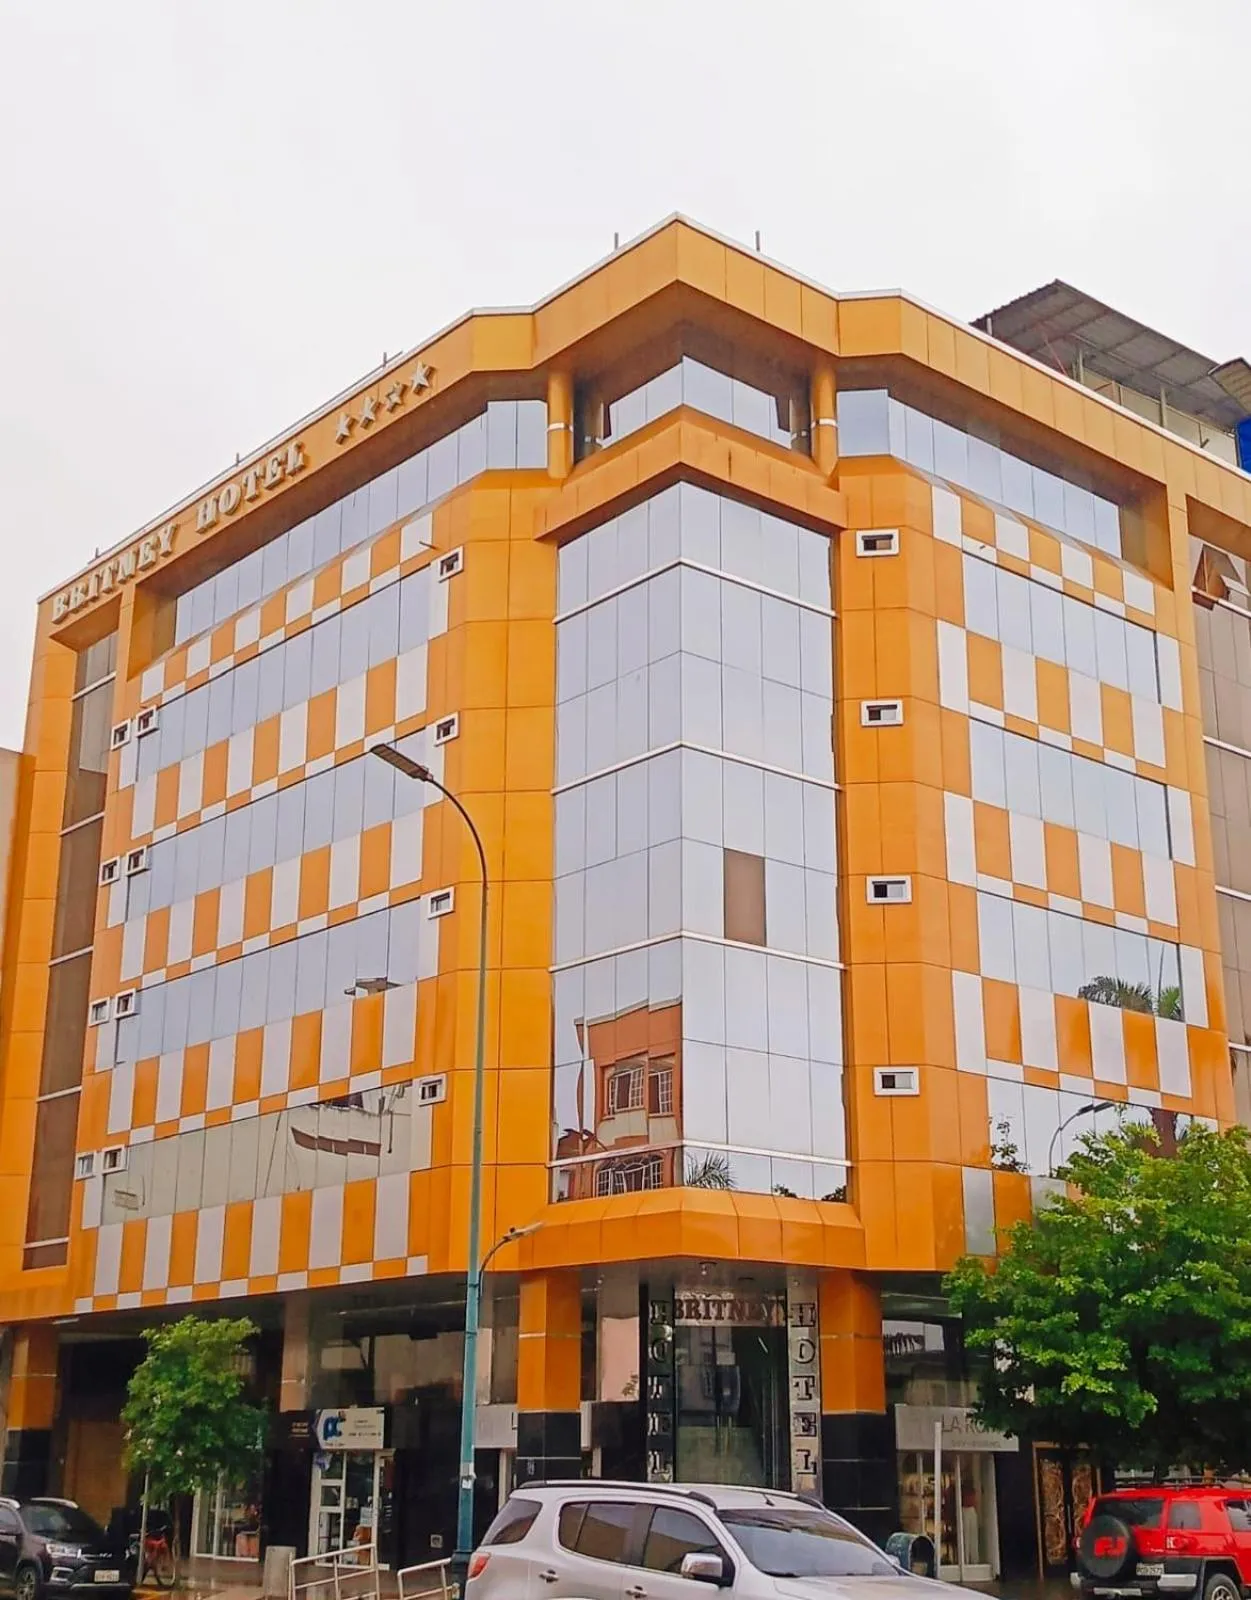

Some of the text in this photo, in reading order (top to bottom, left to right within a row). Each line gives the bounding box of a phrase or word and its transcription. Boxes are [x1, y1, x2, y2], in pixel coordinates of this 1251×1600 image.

[51, 440, 309, 624] BRITNEY HOTEL
[674, 1298, 777, 1321] BRITNEY
[792, 1302, 818, 1475] HOTEL
